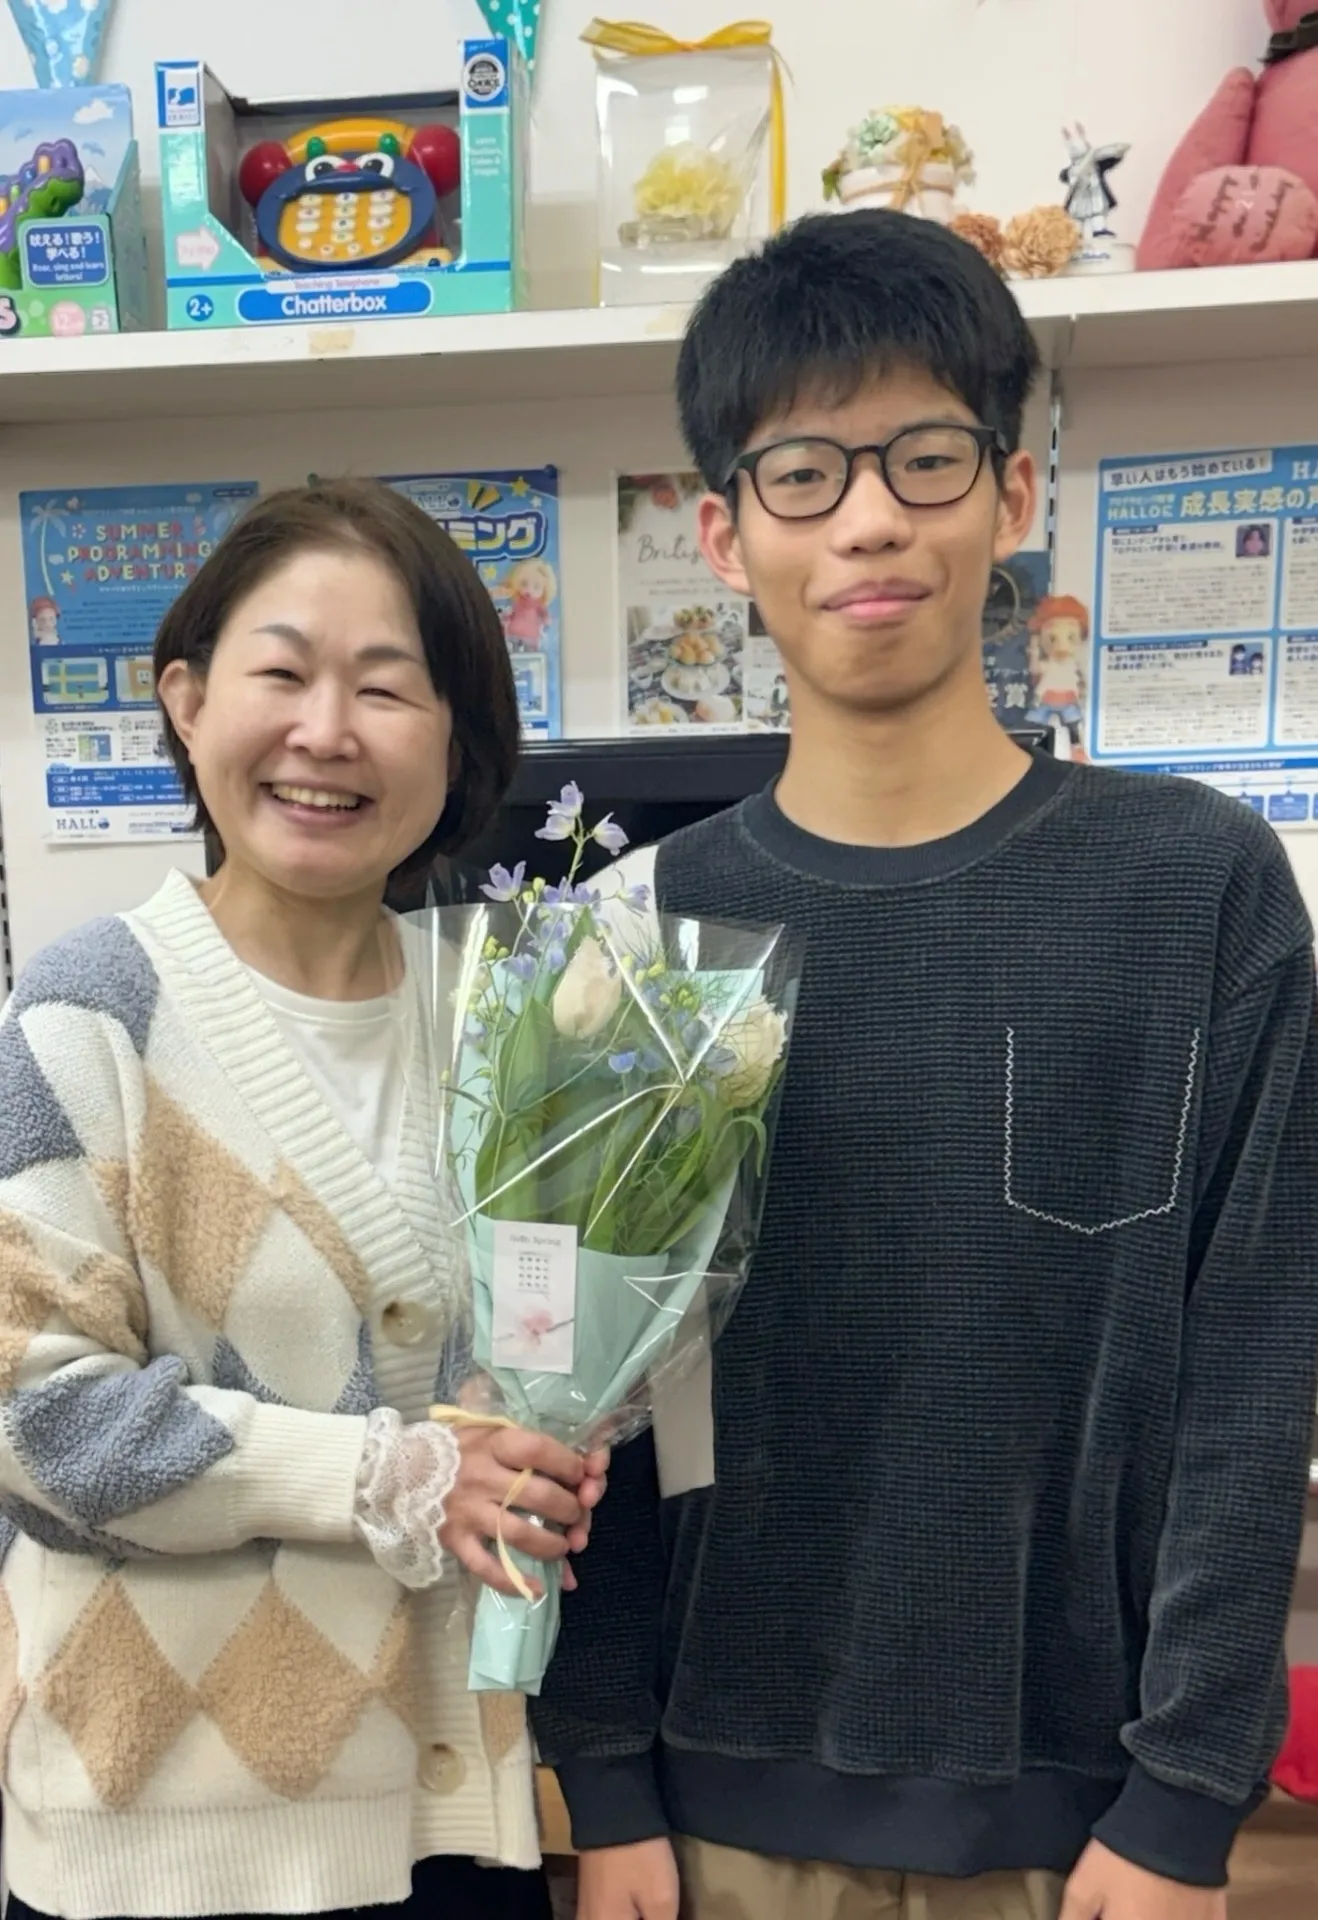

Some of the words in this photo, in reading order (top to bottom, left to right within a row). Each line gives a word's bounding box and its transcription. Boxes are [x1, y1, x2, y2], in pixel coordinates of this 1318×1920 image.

[189, 298, 213, 317] 2+
[281, 291, 387, 316] Chatterbox
[1110, 456, 1267, 487] 早い人はもう始めている！
[96, 521, 183, 542] SUMMER
[437, 515, 537, 551] ミング
[67, 540, 212, 563] PROGRAMMING
[637, 533, 702, 565] Britis
